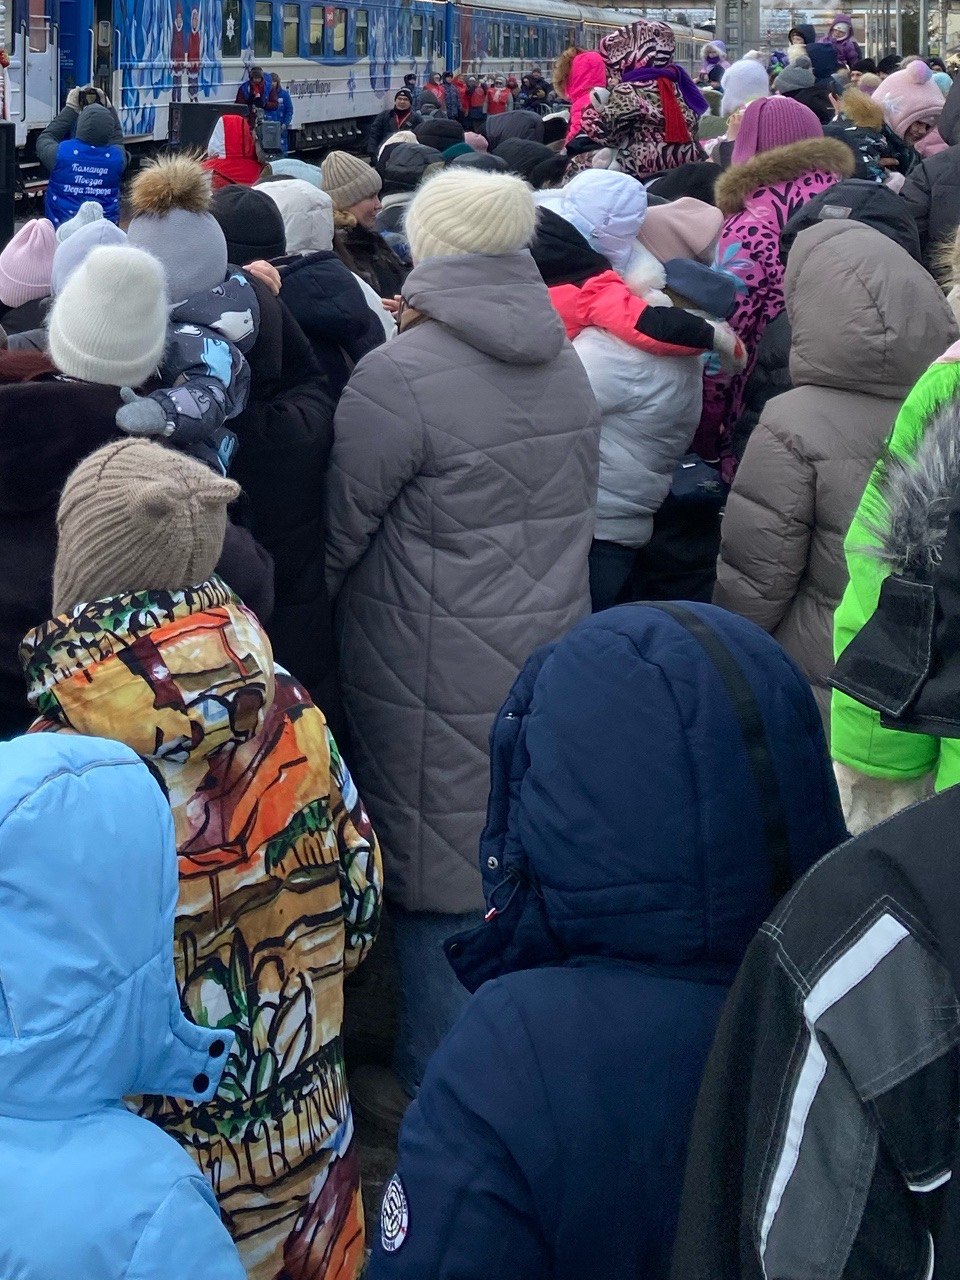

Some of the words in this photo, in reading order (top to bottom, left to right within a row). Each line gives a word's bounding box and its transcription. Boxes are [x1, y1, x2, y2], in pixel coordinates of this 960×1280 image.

[71, 163, 109, 176] Команда
[74, 175, 104, 187] Поезда
[63, 184, 85, 196] Деда
